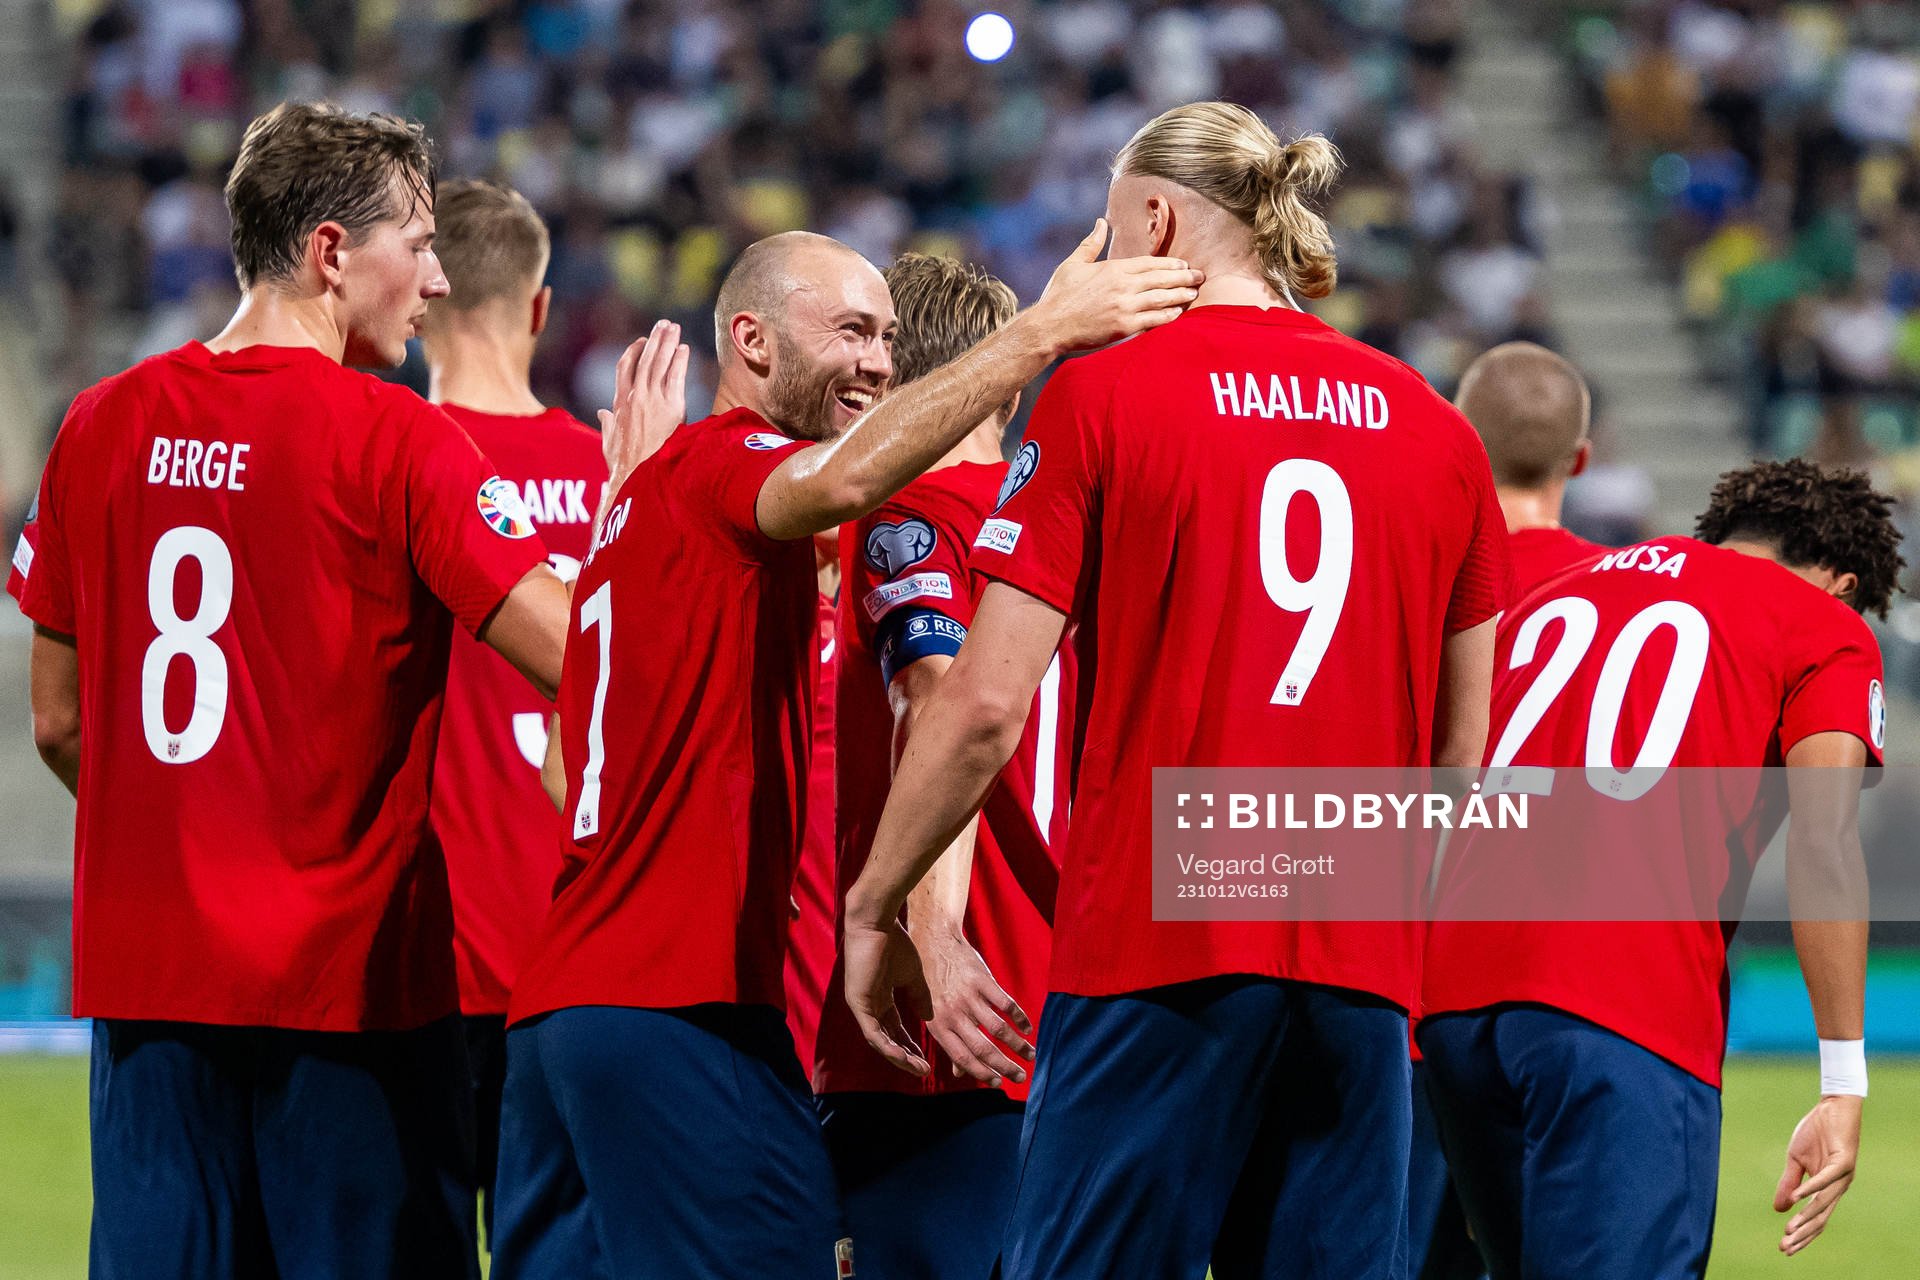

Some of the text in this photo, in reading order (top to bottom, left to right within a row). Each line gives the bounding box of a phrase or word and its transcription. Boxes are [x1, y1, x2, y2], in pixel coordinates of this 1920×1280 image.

[1209, 372, 1389, 430] HAALAND
[147, 436, 251, 491] BERGE
[1259, 458, 1353, 706] 9
[1590, 545, 1687, 579] NUSA
[867, 579, 950, 610] FOUNDATION
[141, 525, 234, 764] 8
[1478, 596, 1710, 802] 20
